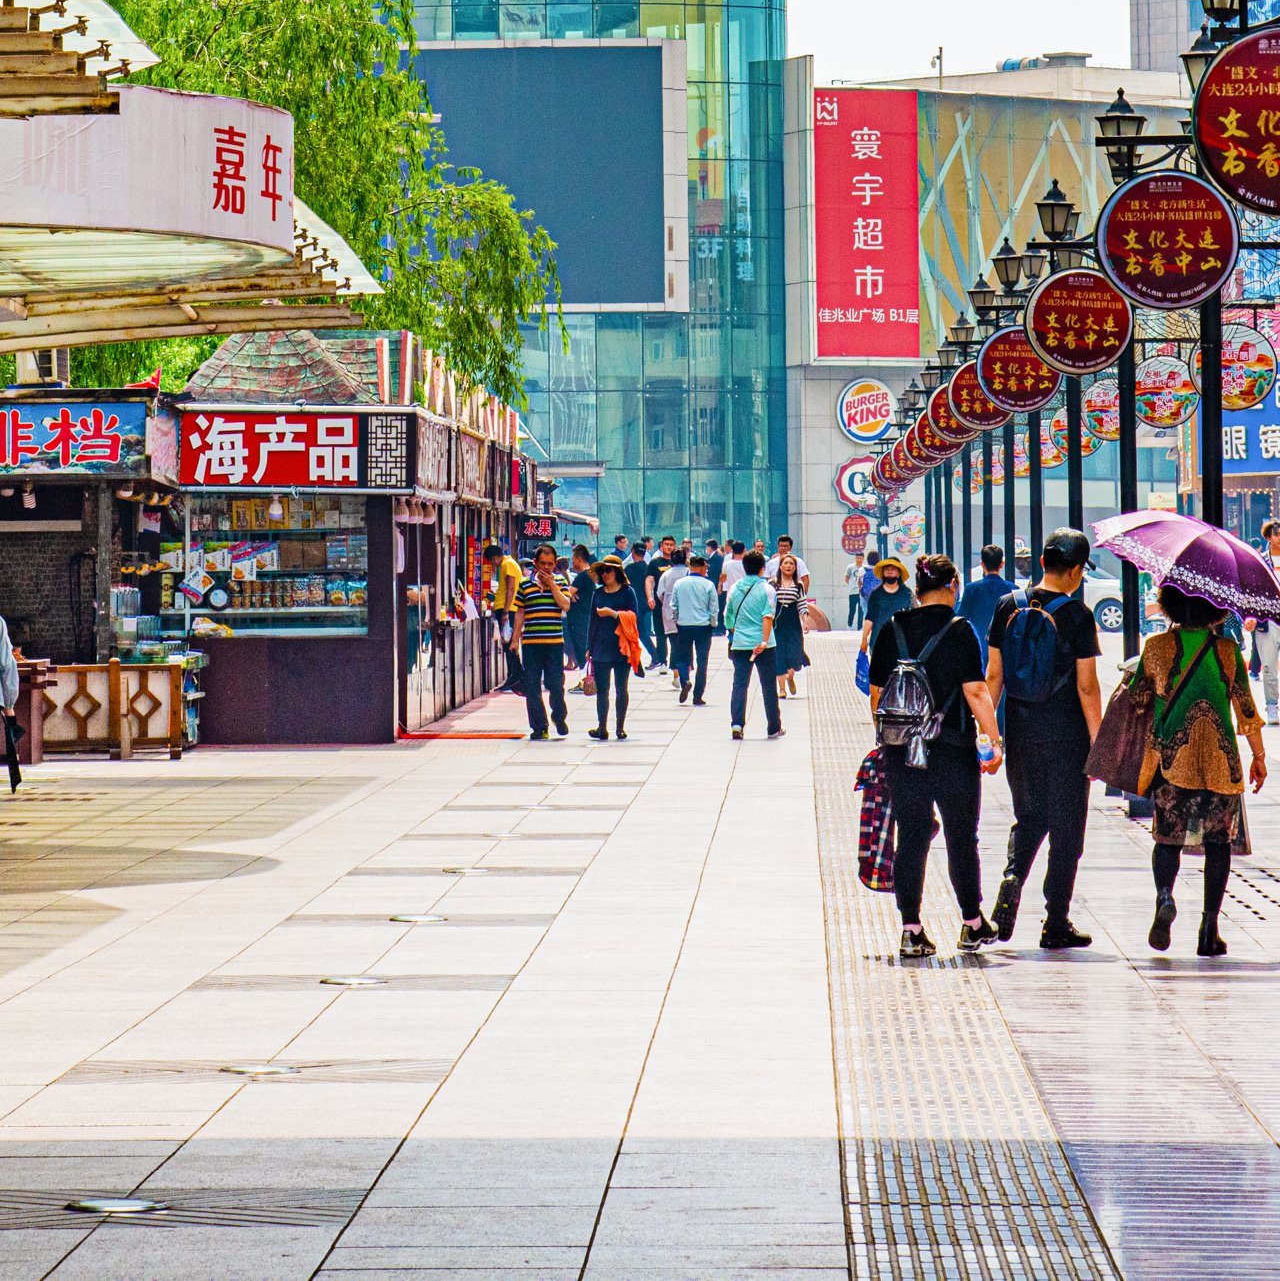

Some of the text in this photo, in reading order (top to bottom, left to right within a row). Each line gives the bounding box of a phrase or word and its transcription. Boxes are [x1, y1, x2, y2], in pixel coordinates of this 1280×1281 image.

[213, 126, 293, 222] 嘉年
[851, 127, 884, 299] 寰宇超市
[1123, 226, 1220, 249] 文化大连
[1125, 250, 1221, 276] 书香中山
[818, 308, 919, 324] 佳兆业广场 B1层
[1045, 311, 1119, 331] 文化大连
[1046, 329, 1119, 350] 书香中山
[992, 362, 1052, 376] 文化大连
[845, 392, 889, 413] BURGER
[960, 388, 984, 400] 文化
[846, 403, 890, 428] KING
[961, 401, 995, 413] 书香中
[189, 414, 358, 484] 海产品
[524, 519, 552, 536] 水果
